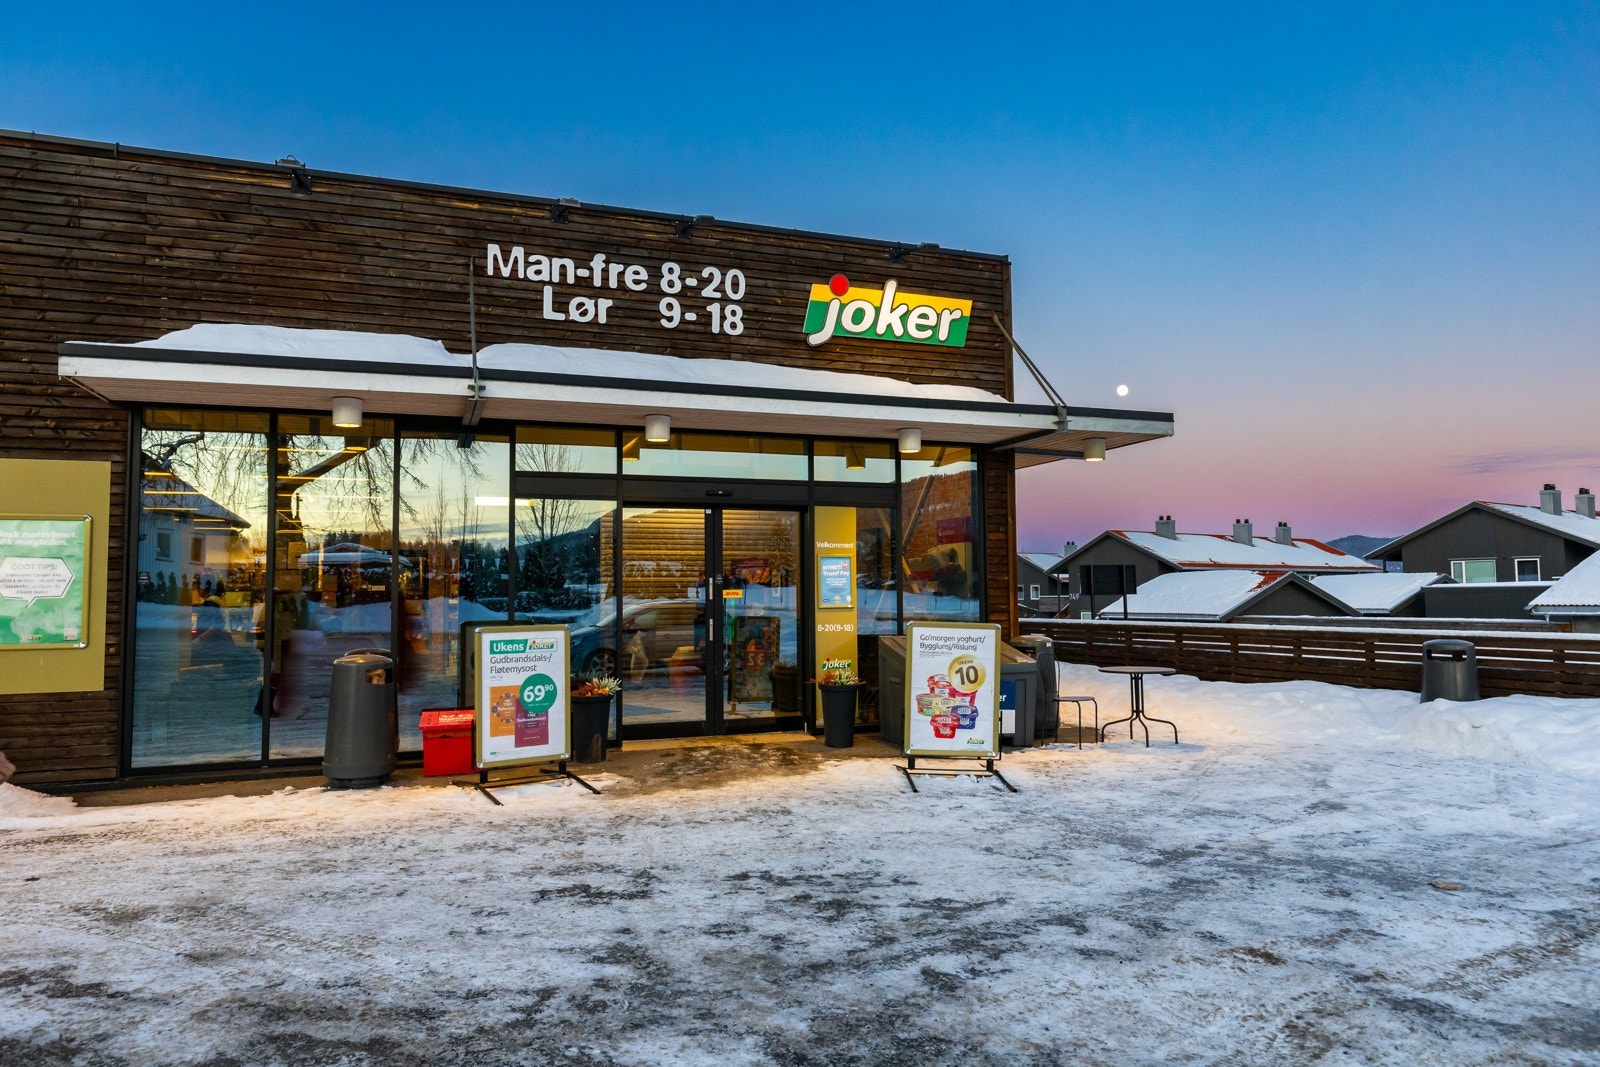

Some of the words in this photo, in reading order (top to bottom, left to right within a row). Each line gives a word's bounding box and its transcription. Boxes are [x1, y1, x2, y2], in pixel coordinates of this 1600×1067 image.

[486, 243, 649, 291] Man-fre
[660, 261, 747, 301] 8-20
[542, 285, 613, 324] Lør
[658, 296, 744, 336] 9-18
[806, 273, 963, 347] joker
[493, 642, 524, 652] Ukens
[919, 634, 956, 643] Go'morgen
[956, 635, 986, 645] yoghurt/
[490, 664, 537, 675] Fløtemysost
[822, 657, 851, 671] joker
[955, 665, 979, 686] 10
